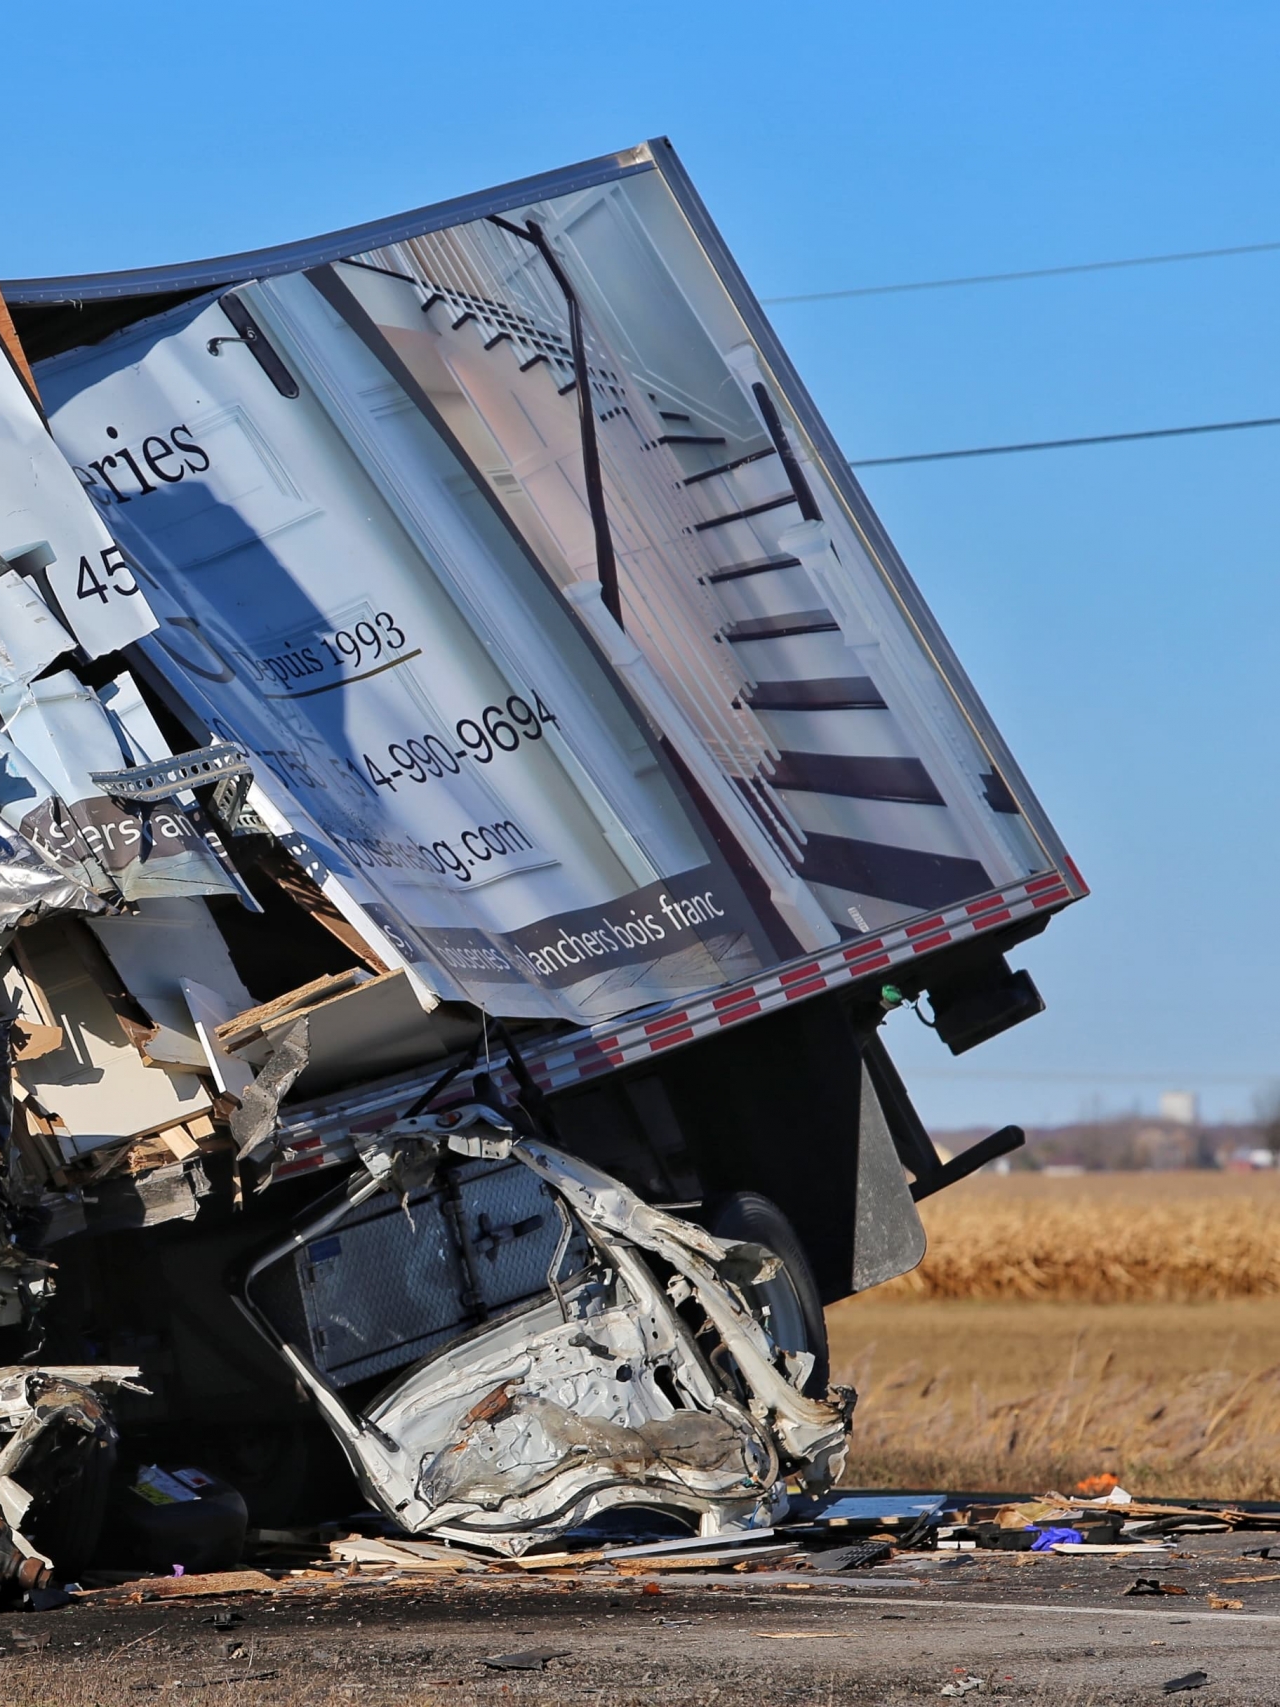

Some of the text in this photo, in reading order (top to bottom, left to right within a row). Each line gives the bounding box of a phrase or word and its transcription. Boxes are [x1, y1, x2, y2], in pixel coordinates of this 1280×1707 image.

[232, 641, 325, 690] Depuis
[320, 612, 406, 668] 1993
[602, 908, 665, 949] bois
[658, 891, 725, 931] franc
